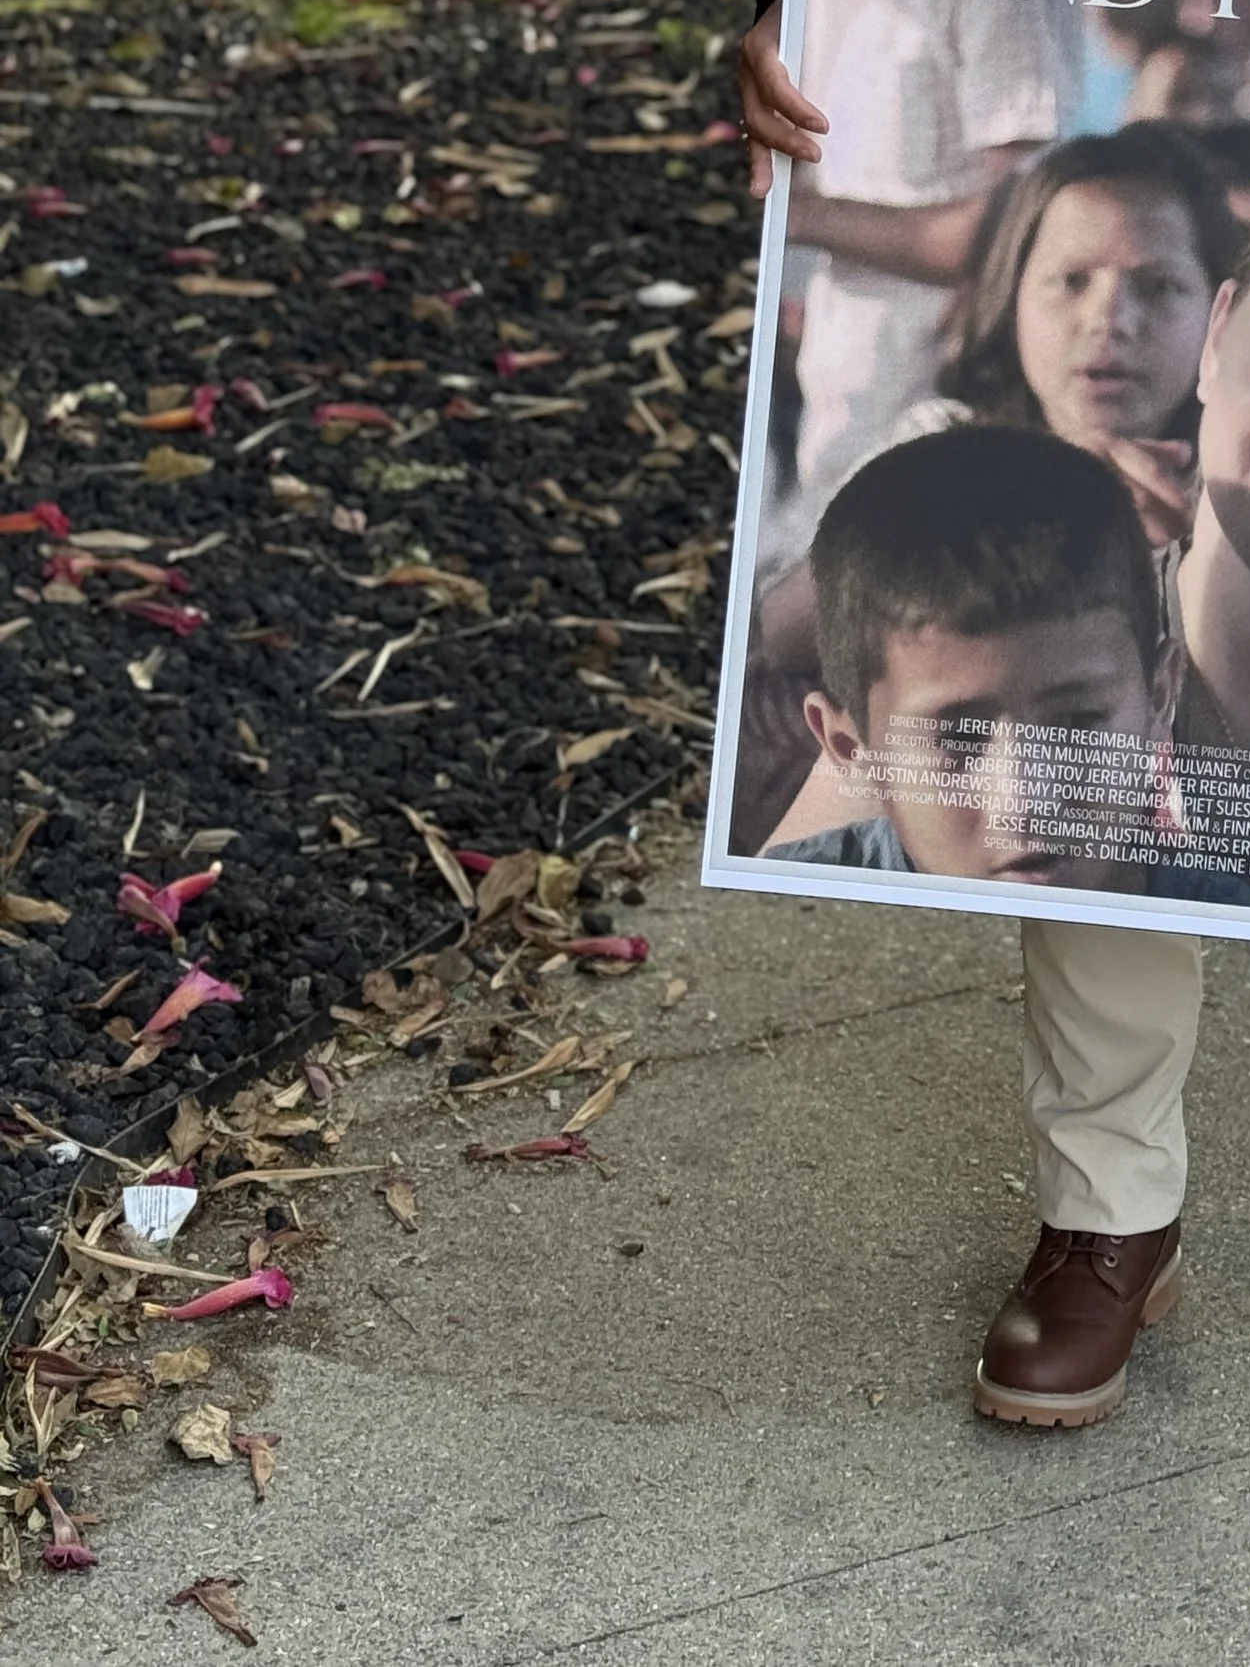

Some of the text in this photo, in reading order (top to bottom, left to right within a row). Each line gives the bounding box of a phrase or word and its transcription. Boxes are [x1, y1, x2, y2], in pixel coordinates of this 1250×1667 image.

[884, 732, 936, 749] EXECUTIVE
[940, 737, 1000, 756] PRODUCERS
[1003, 740, 1050, 761] KAREN
[1054, 745, 1129, 769] MULVANEY
[1132, 752, 1163, 772] TOM
[1165, 756, 1241, 780] MULVANEY
[890, 714, 936, 731] DIRECTED
[940, 719, 952, 732] BY
[956, 718, 1010, 739] JEREMY
[1014, 724, 1066, 745] POWER
[1070, 729, 1143, 752] REGIMBAL
[1146, 740, 1197, 757] EXECUTIVE
[867, 764, 920, 786] AUSTIN
[920, 769, 990, 793] ANDREWS
[992, 776, 1049, 798] JEREMY
[1052, 782, 1104, 804] POWER
[1184, 795, 1214, 815] PIET
[944, 757, 957, 770] BY
[964, 756, 1021, 777] ROBERT
[1023, 761, 1086, 784] MENTOV
[1085, 767, 1141, 789] JEREMY
[1144, 773, 1195, 794] POWER
[873, 787, 933, 806] SUPERVISOR
[937, 790, 1000, 813] NATASHA
[1003, 796, 1060, 819] DUPREY
[1062, 807, 1116, 824] ASSOCIATE
[1119, 812, 1179, 831] PRODUCERS
[1182, 814, 1209, 833] KIM
[1212, 820, 1220, 835] &
[983, 834, 1025, 852] SPECIAL
[1027, 839, 1065, 856] THANKS
[1068, 844, 1080, 858] TO
[1084, 841, 1096, 859] S.
[1100, 843, 1158, 866] DILLARD
[1161, 853, 1170, 867] &
[1172, 851, 1245, 875] ADRIENNE
[986, 813, 1026, 833] JESSE
[1029, 818, 1101, 841] REGIMBAL
[1103, 825, 1154, 847] AUSTIN
[1156, 830, 1228, 854] ANDREWS
